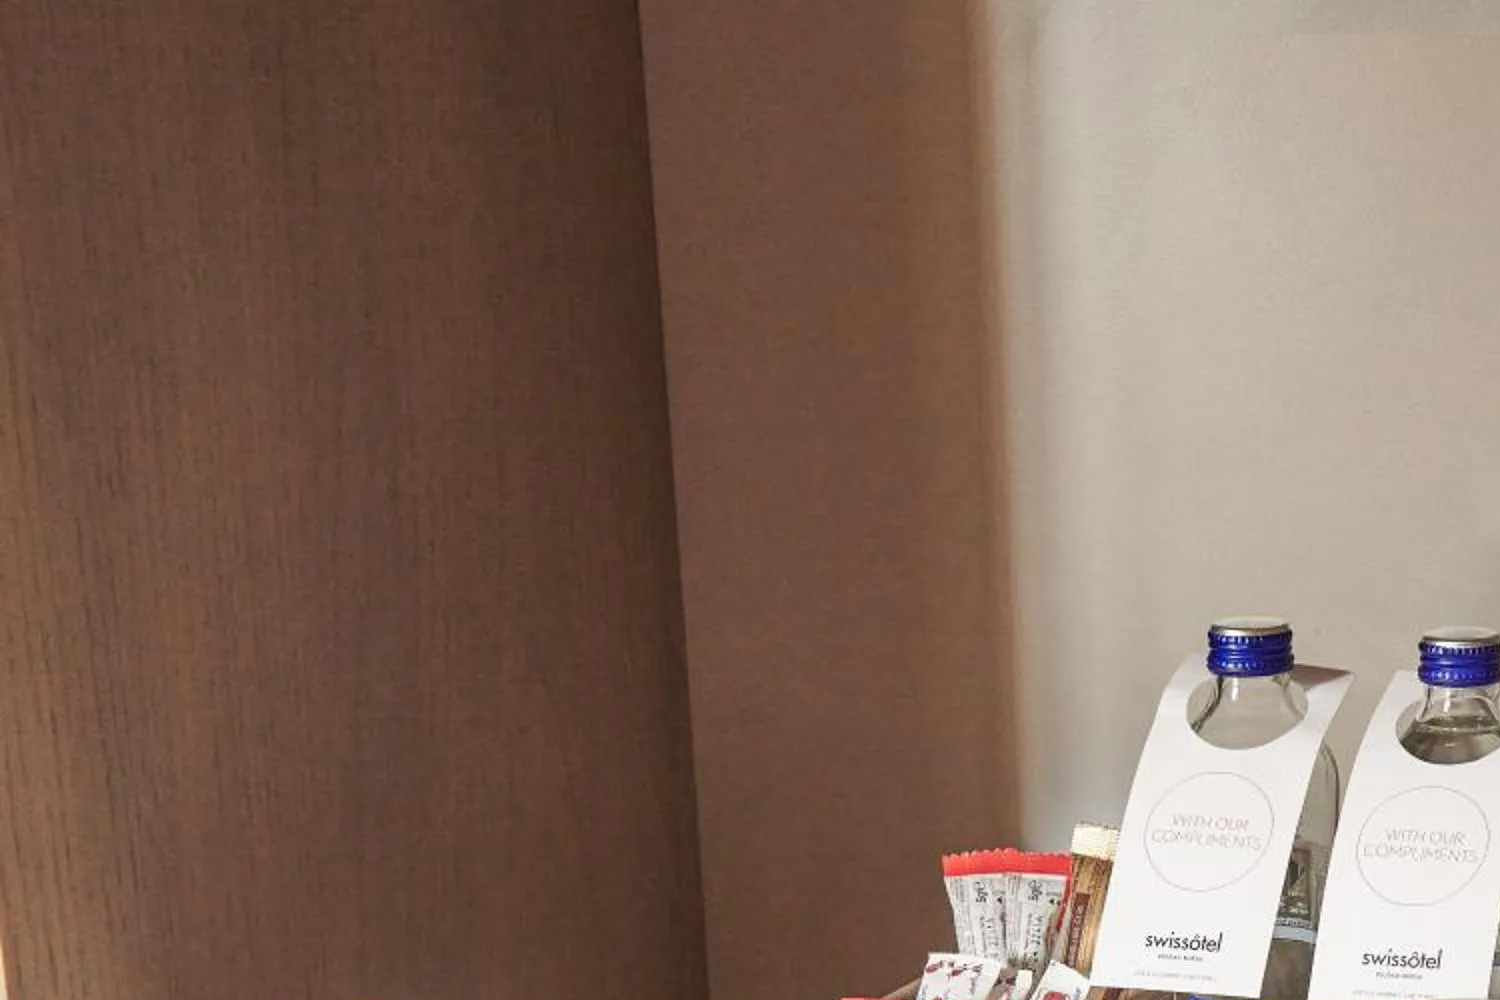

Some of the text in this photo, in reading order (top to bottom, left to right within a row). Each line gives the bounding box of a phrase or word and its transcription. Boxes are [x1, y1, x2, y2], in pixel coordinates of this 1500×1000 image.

[1172, 813, 1250, 831] WITH OUR
[1152, 829, 1262, 851] COMPLIMENTS
[1385, 829, 1467, 847] WITH OUR
[1363, 843, 1478, 864] COMPLIMENTS
[1145, 931, 1223, 952] swissôtel
[1361, 948, 1443, 969] swissôtel
